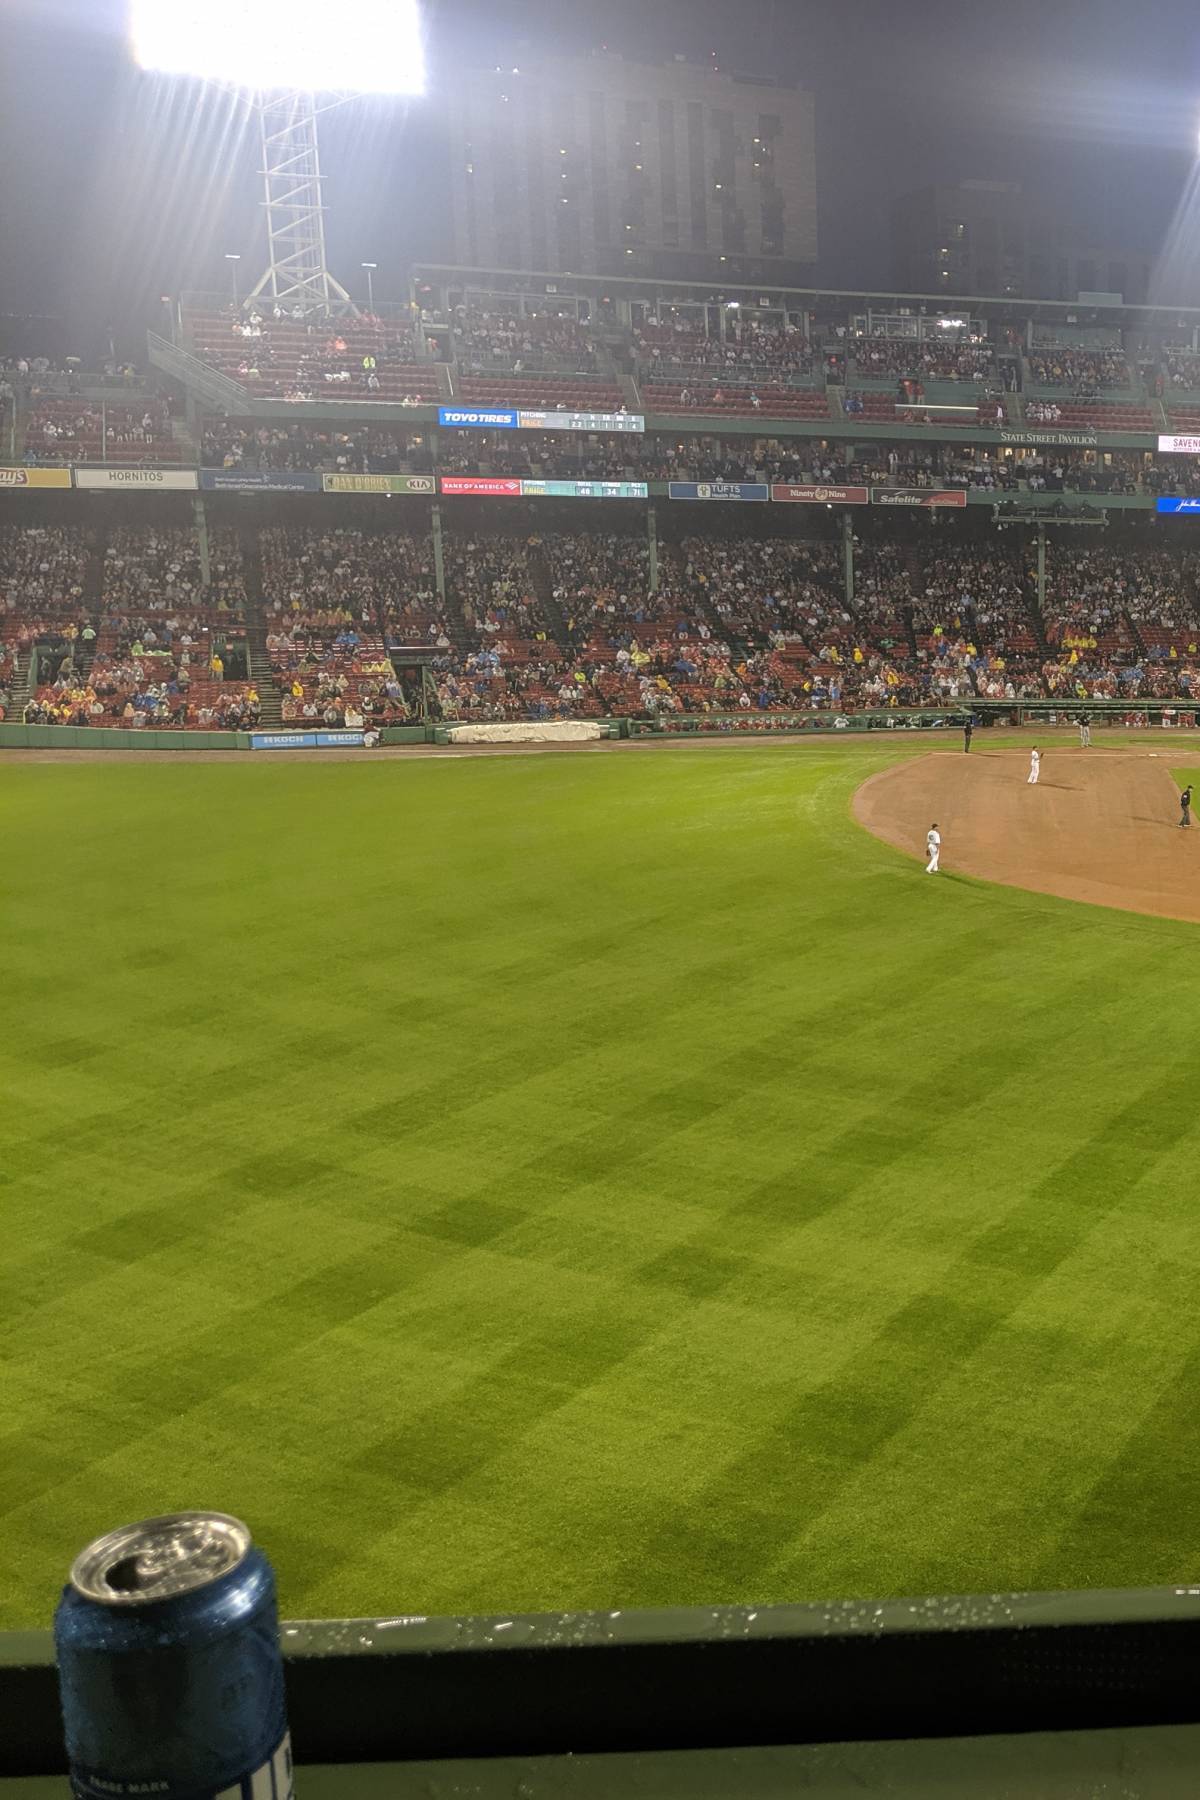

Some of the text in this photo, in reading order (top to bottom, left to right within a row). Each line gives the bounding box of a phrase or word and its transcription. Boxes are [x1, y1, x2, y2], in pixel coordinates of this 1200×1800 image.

[444, 413, 512, 423] TOYO TIRES
[1001, 432, 1097, 444] STATE STREET PAVILION
[0, 469, 25, 484] ay's
[109, 472, 163, 481] HORNITOS
[790, 490, 815, 498] Ninety
[880, 495, 923, 504] Safelite
[128, 1782, 170, 1793] MARK
